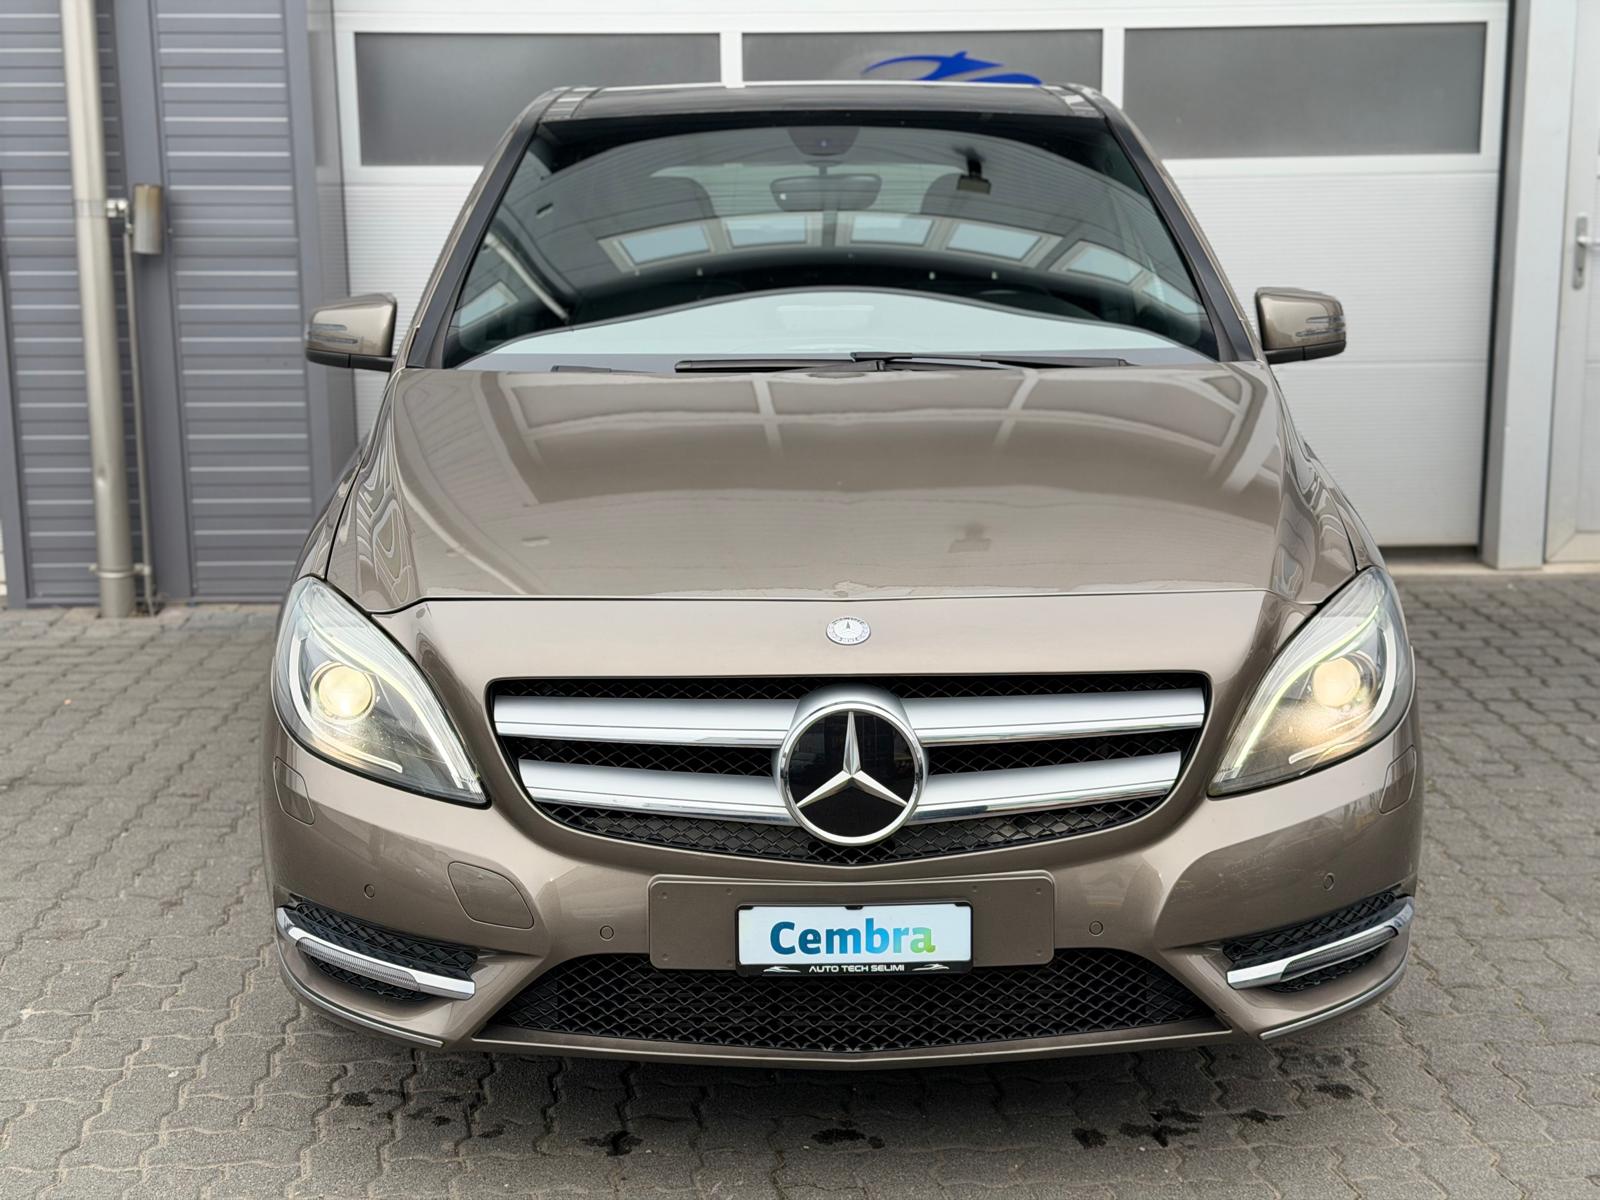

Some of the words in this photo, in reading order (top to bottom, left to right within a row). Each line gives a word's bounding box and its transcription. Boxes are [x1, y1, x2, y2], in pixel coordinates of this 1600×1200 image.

[770, 918, 936, 955] Cembra
[808, 965, 840, 973] AUTO
[842, 964, 869, 973] TECH
[870, 964, 905, 972] SELIMI
